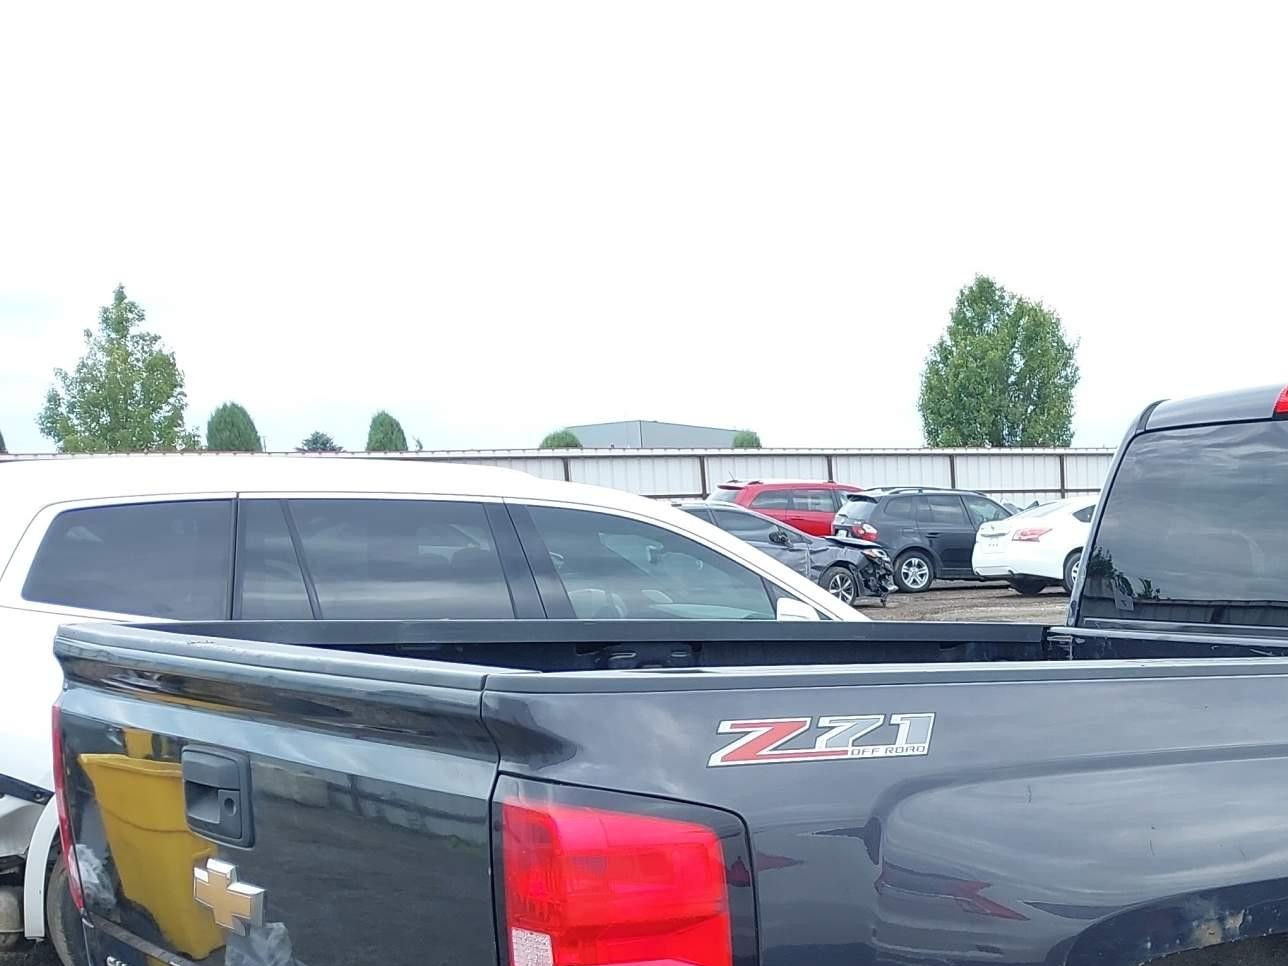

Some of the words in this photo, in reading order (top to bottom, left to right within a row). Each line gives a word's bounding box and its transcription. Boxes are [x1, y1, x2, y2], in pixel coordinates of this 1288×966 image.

[706, 712, 936, 768] Z71
[851, 748, 880, 756] OFF
[885, 745, 926, 754] ROAD
